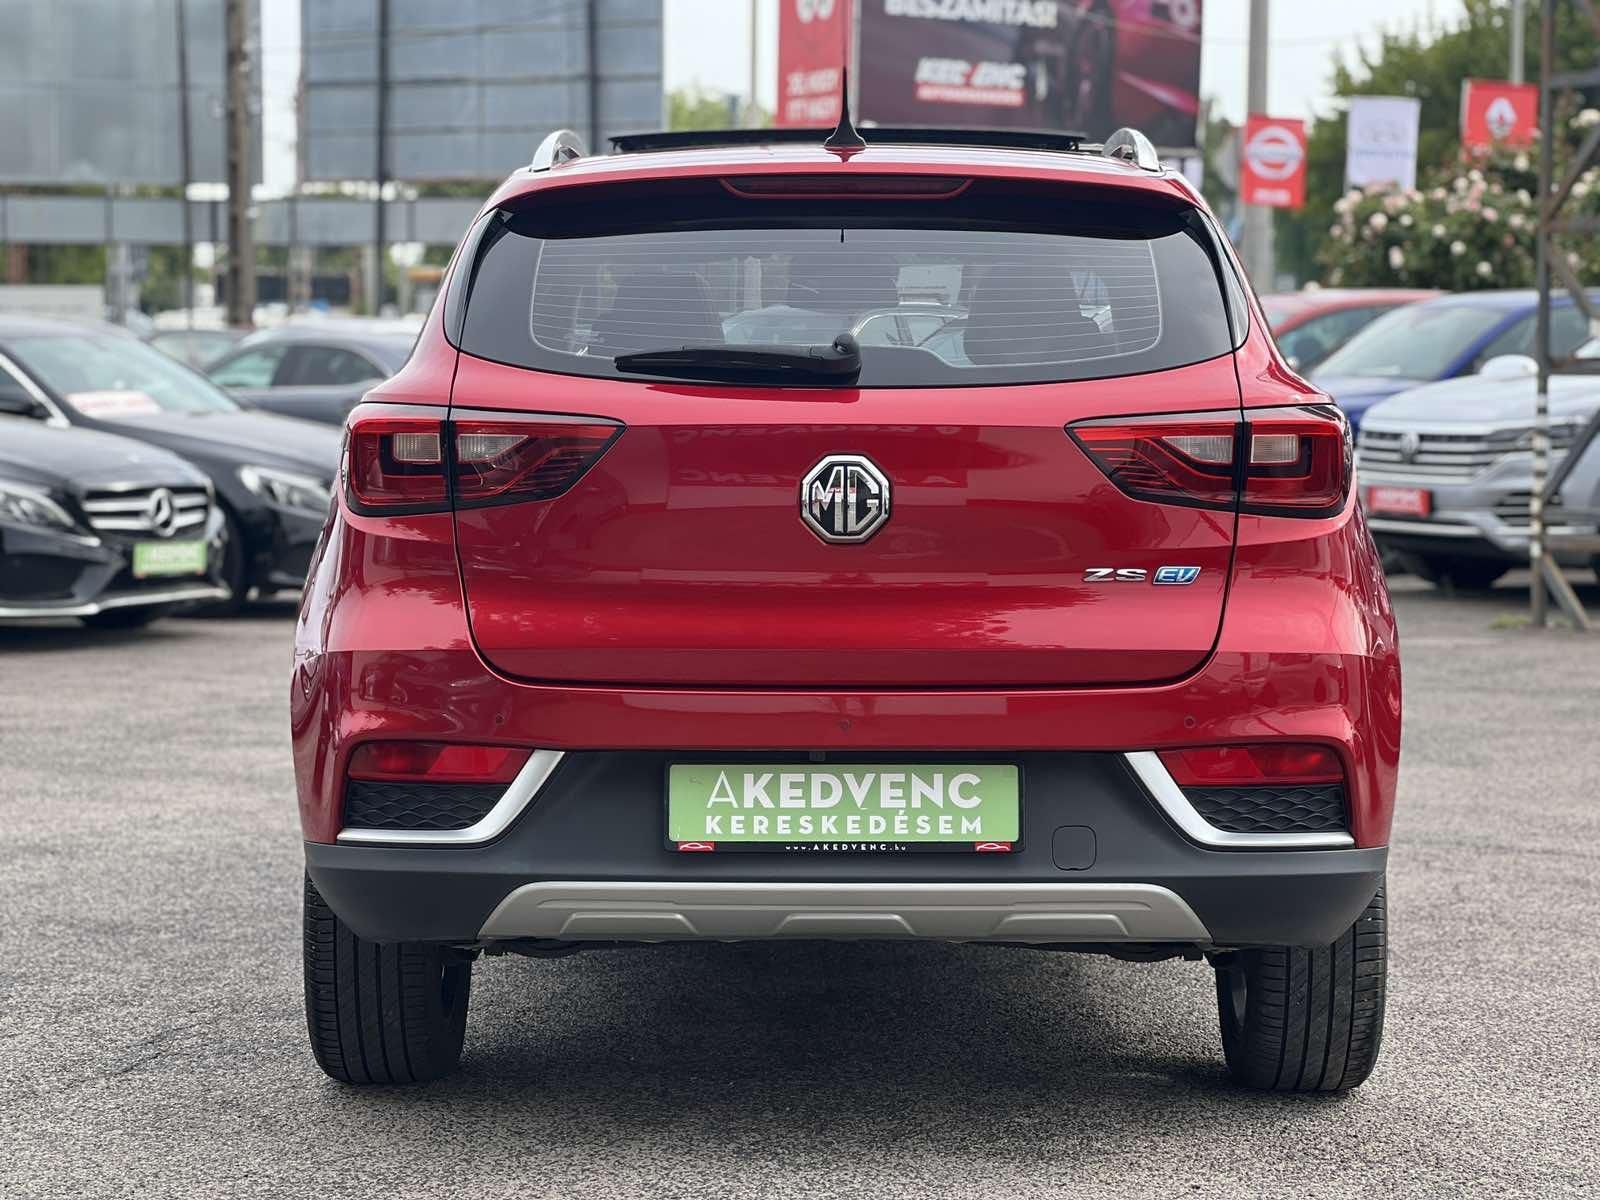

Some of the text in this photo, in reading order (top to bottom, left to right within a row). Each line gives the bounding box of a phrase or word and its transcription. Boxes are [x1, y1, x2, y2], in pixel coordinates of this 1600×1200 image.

[812, 465, 880, 533] MG
[1083, 567, 1197, 582] ZS EV
[705, 809, 983, 835] KERESKEDÉSEM
[785, 843, 907, 852] www.AKEDVENC.hu
